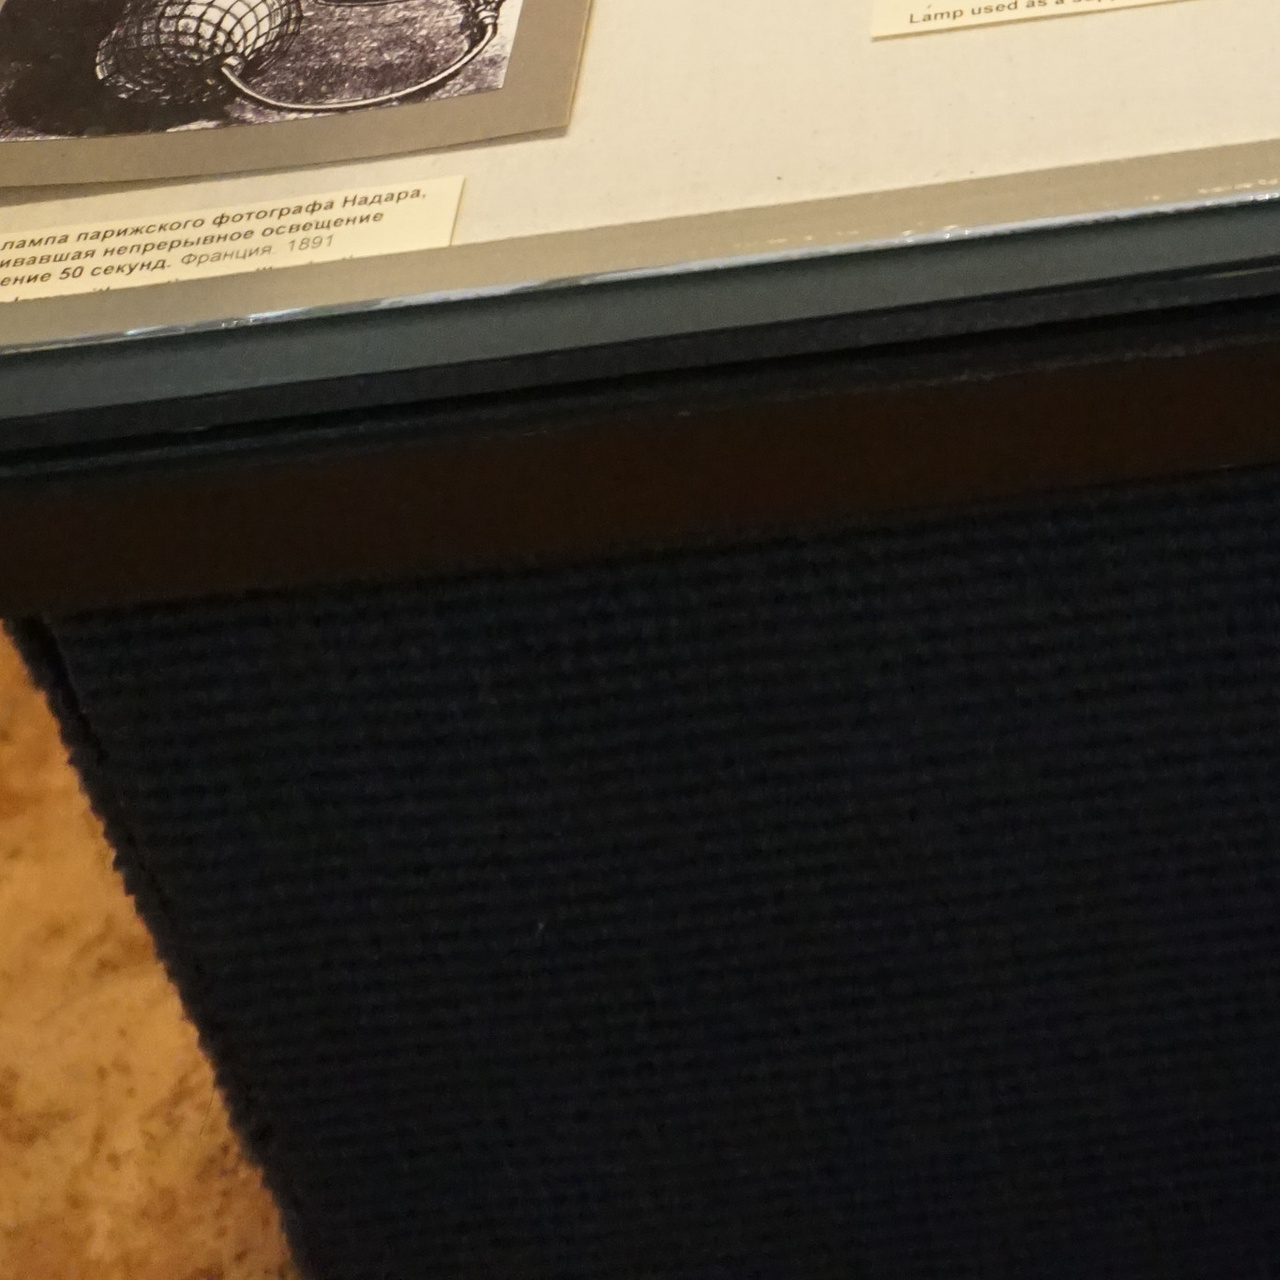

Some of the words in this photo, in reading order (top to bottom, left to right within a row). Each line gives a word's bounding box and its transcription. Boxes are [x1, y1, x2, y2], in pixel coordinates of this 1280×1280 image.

[909, 8, 964, 24] Lamp
[970, 0, 1019, 16] used
[0, 234, 69, 251] лампа
[76, 218, 205, 243] парижского
[211, 200, 335, 228] фотографа
[341, 188, 427, 208] Надара,
[102, 228, 255, 257] непрерывное
[261, 211, 385, 238] освещение
[58, 266, 85, 280] 50
[90, 259, 171, 278] секунд.
[287, 234, 336, 253] 1891
